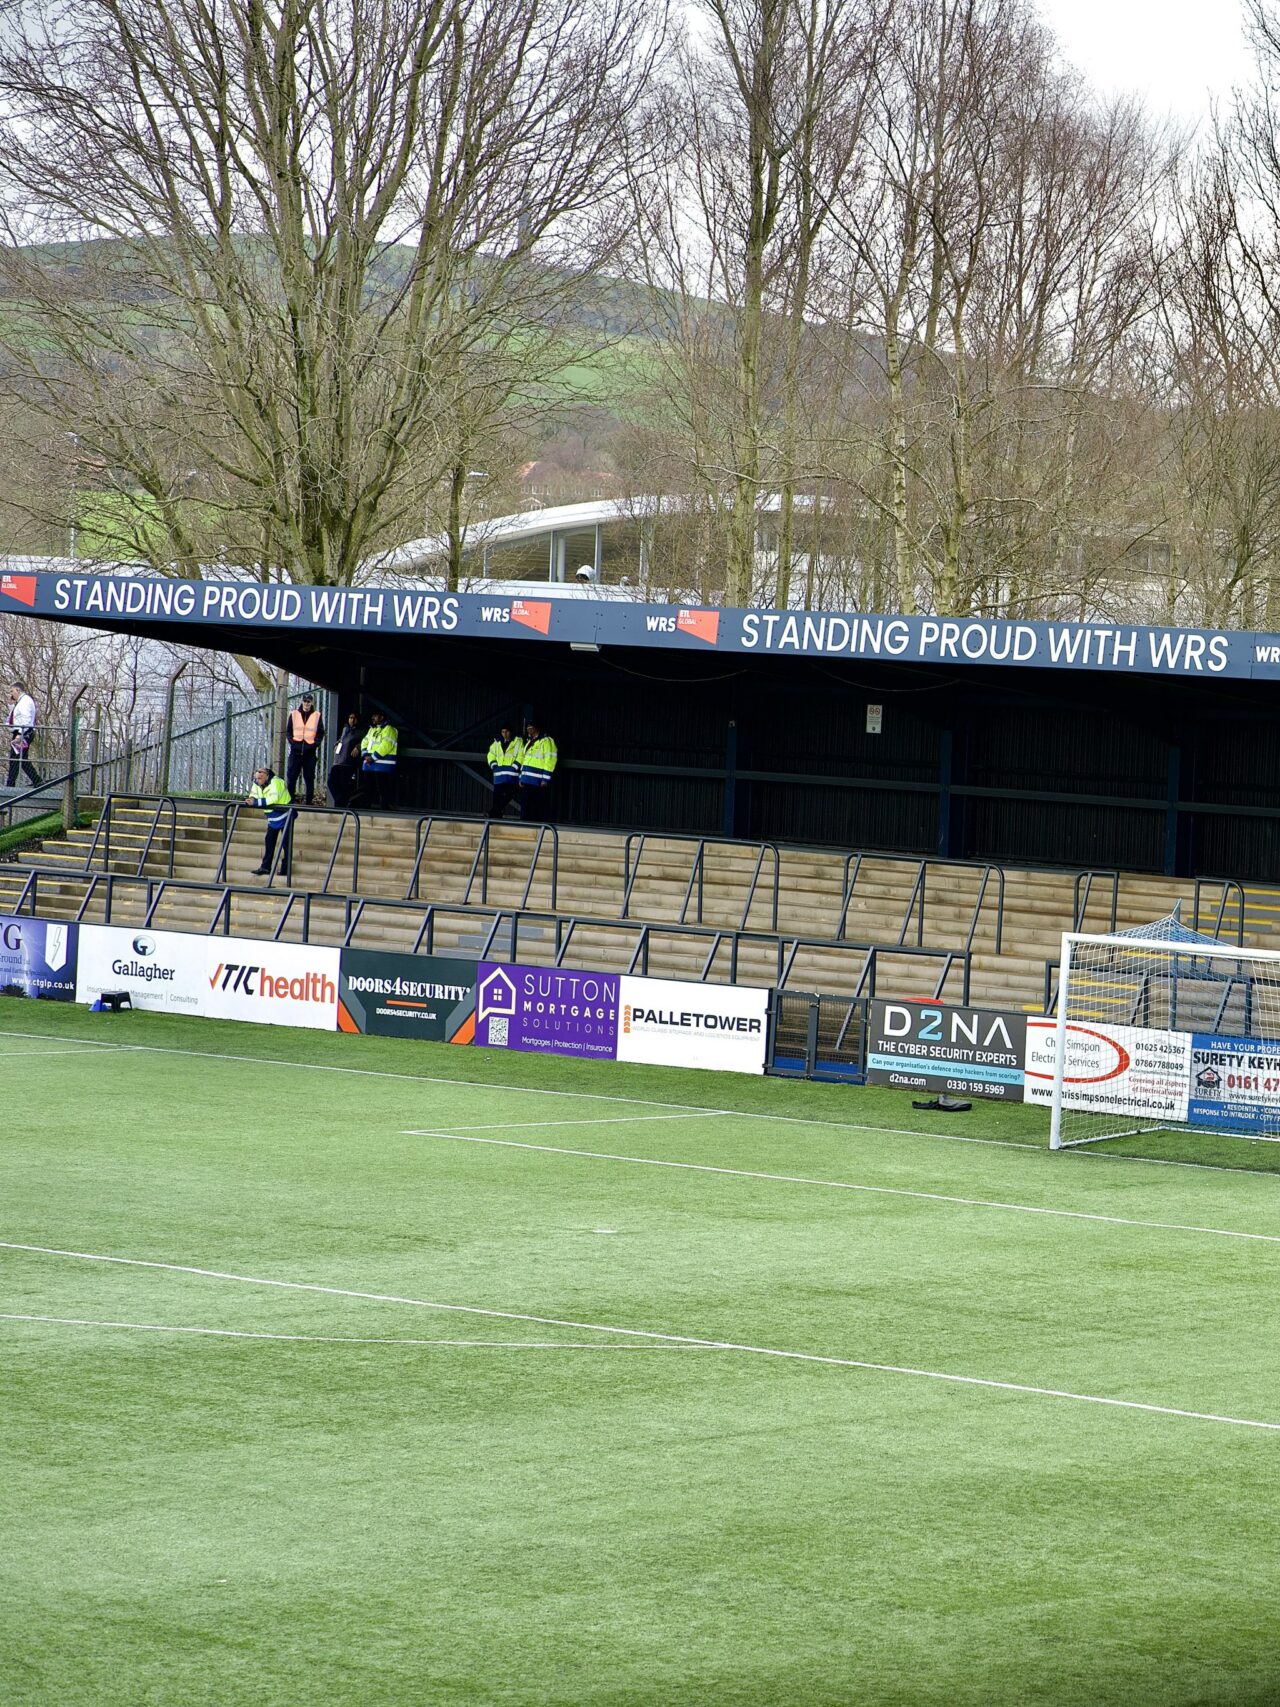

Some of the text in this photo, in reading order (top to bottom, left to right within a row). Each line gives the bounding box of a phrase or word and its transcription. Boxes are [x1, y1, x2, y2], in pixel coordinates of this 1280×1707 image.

[54, 578, 459, 630] STANDING PROUD WITH WRS
[512, 608, 530, 616] GLOBAL
[481, 606, 510, 624] WRS
[678, 617, 697, 625] GLOBAL
[679, 609, 690, 618] ETL
[646, 615, 676, 633] WRS
[740, 613, 1230, 673] STANDING PROUD WITH WRS
[112, 959, 175, 982] Gallagher
[524, 974, 616, 1003] SUTTON
[170, 994, 198, 1004] Consulting
[523, 1001, 615, 1020] MORTGAGE
[522, 1017, 614, 1036] SOLUTIONS
[632, 1007, 761, 1033] PALLETOWER
[522, 1036, 612, 1053] Mortgages Protection Insurance
[1136, 1042, 1158, 1052] 01625
[1211, 1041, 1231, 1050] HAVE
[1234, 1042, 1255, 1052] YOUR
[877, 1040, 1017, 1066] THE CYBER SECURITY EXPERTS
[1031, 1052, 1100, 1068] Electril Services
[1193, 1052, 1245, 1068] SURETY
[896, 1061, 930, 1071] organisation's
[932, 1065, 951, 1073] defence
[952, 1066, 964, 1075] stop
[964, 1068, 984, 1076] hackers
[985, 1070, 997, 1078] from
[998, 1072, 1021, 1081] scoring?
[889, 1073, 926, 1086] d2na.com
[946, 1079, 1005, 1095] 0330 159 5969
[1129, 1076, 1155, 1086] Covering
[1227, 1074, 1259, 1090] 0161
[1194, 1086, 1222, 1096] SURETY
[1193, 1108, 1220, 1116] RESPONSE
[1230, 1111, 1255, 1120] INTRUDER
[1227, 1104, 1260, 1112] RESIDENTIAL
